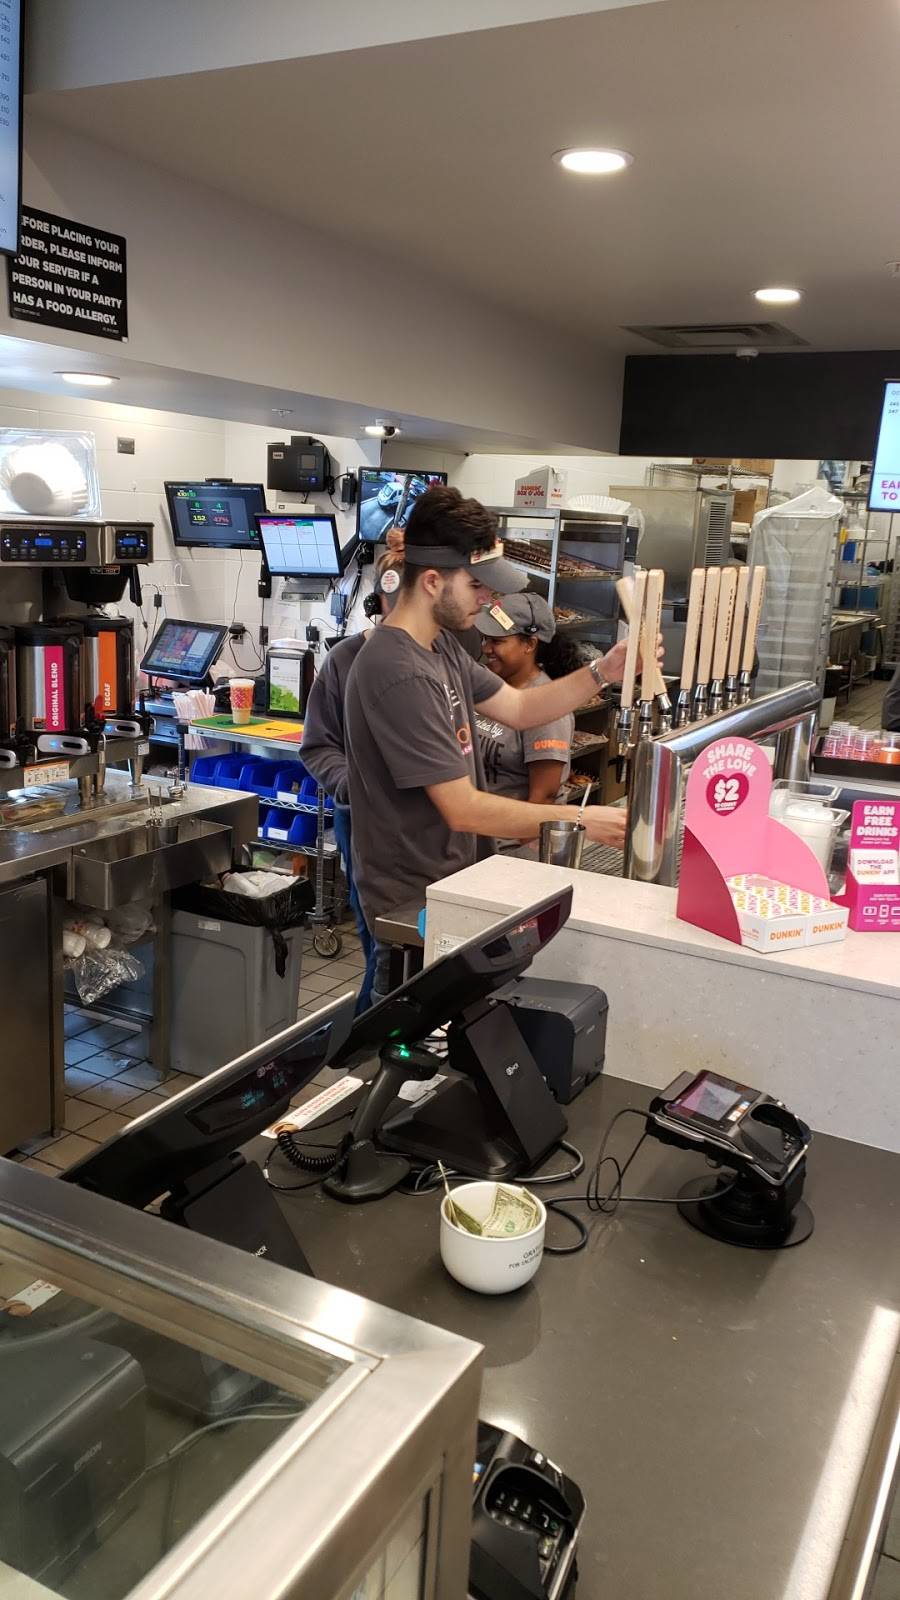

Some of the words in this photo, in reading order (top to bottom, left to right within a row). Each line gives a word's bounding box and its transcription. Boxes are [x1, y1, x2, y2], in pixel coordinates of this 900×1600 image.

[22, 215, 49, 234] FORE
[51, 225, 92, 246] PLACING
[94, 238, 120, 255] YOUR
[21, 235, 48, 254] RDER,
[50, 243, 86, 263] PLEASE
[88, 254, 123, 273] INFORM
[42, 261, 80, 280] SERVER
[81, 271, 90, 282] IF
[92, 274, 99, 285] A
[12, 272, 52, 292] PERSON
[54, 282, 65, 295] IN
[65, 285, 91, 302] YOUR
[93, 294, 122, 309] PARTY
[13, 291, 34, 306] HAS
[36, 298, 45, 308] A
[46, 300, 73, 315] FOOD
[75, 307, 117, 325] ALLERGY.
[882, 492, 898, 501] TO
[51, 689, 59, 727] ORIGINAL
[707, 743, 755, 764] SHARE
[702, 760, 726, 779] THE
[726, 758, 757, 777] LOVE
[713, 778, 740, 803] $2
[863, 805, 896, 816] EARN
[863, 816, 894, 826] FREE
[856, 826, 898, 837] DRINKS
[255, 1245, 268, 1257] NCR
